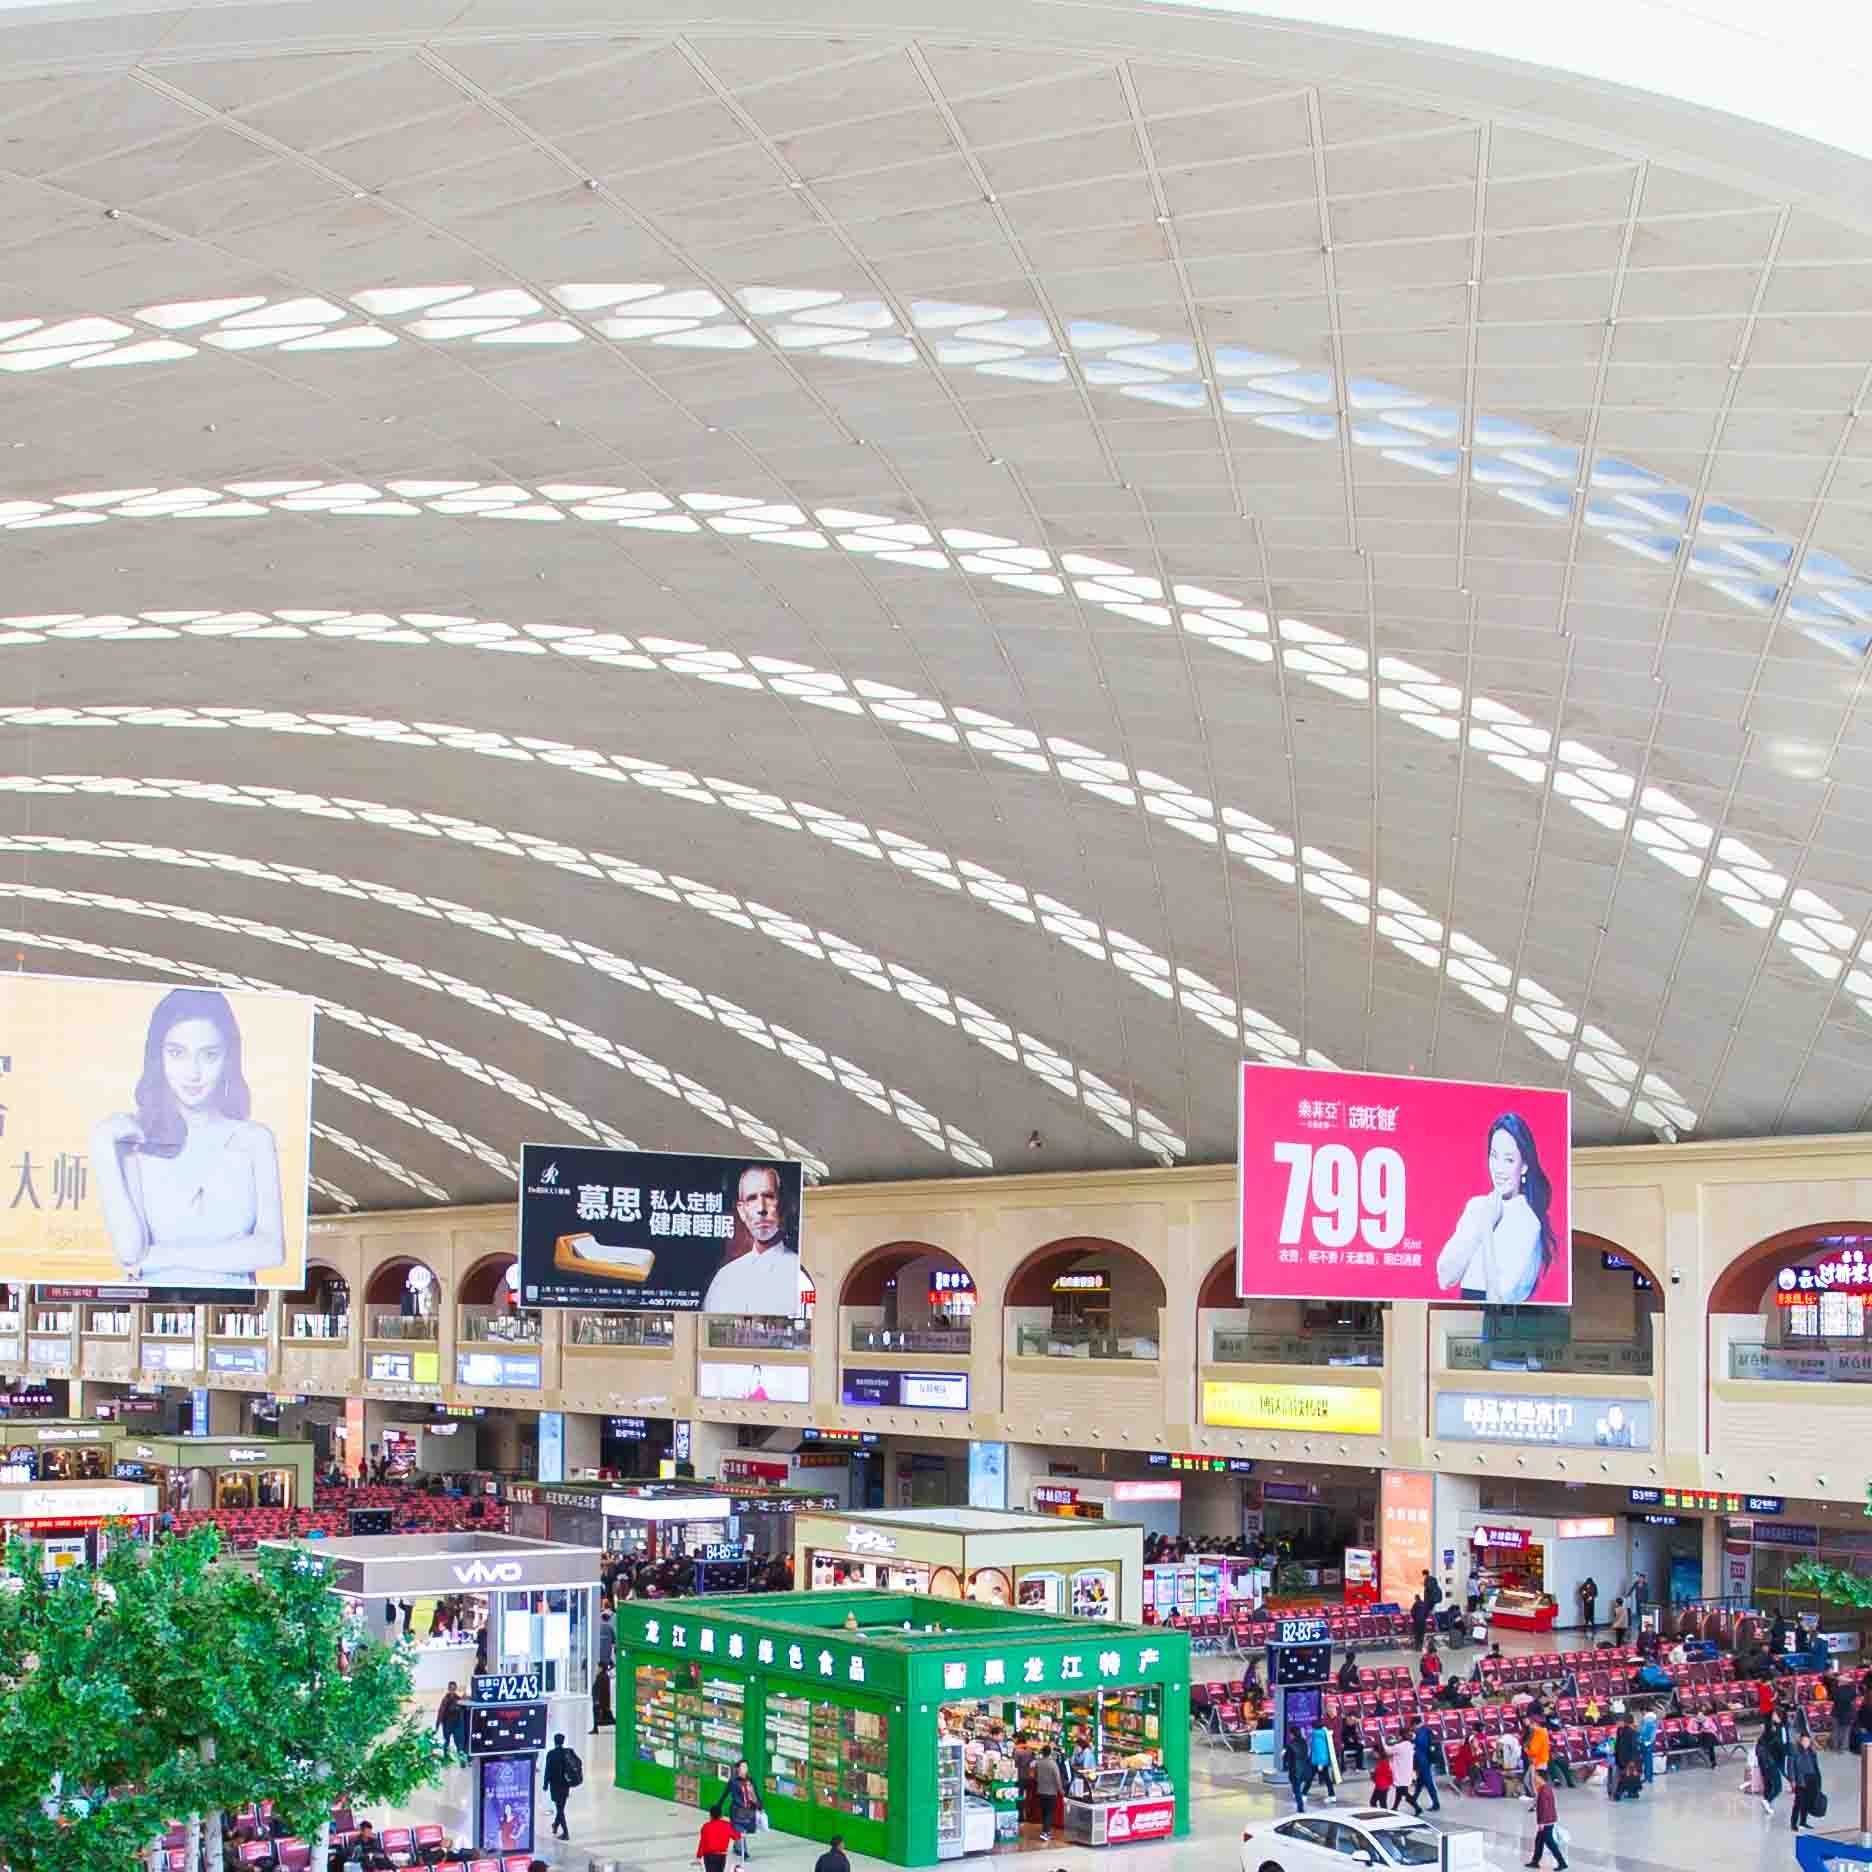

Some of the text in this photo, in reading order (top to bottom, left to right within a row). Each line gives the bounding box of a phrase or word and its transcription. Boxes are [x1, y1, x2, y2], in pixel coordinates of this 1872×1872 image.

[577, 1184, 642, 1222] 慕思
[650, 1189, 724, 1214] 私人定制
[1273, 1141, 1407, 1250] 799
[649, 1214, 736, 1239] 健康睡眠
[453, 1559, 522, 1585] vivo
[983, 1646, 1161, 1687] 黑龙江特产
